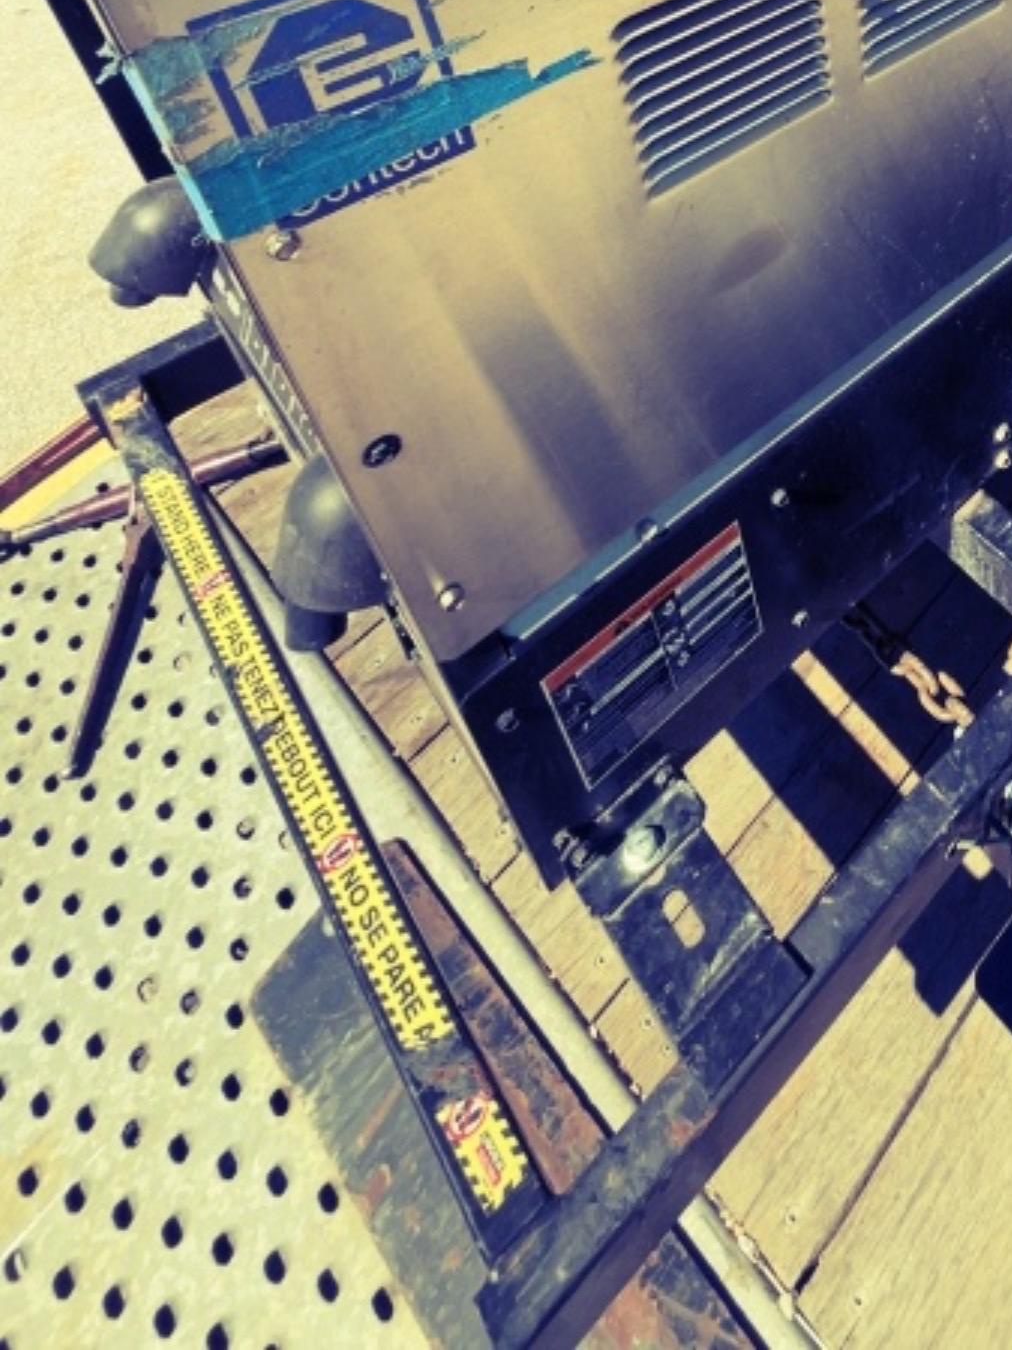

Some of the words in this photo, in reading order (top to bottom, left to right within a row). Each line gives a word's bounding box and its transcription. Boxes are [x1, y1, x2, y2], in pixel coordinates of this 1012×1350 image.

[155, 484, 190, 535] STAND
[180, 534, 212, 574] HERE
[209, 593, 233, 620] NE
[225, 620, 250, 658] PAS
[241, 656, 280, 715] TENEZ
[309, 803, 336, 840] ICI
[338, 865, 369, 907] NO
[359, 906, 389, 948] SE
[377, 944, 427, 1024] PARE
